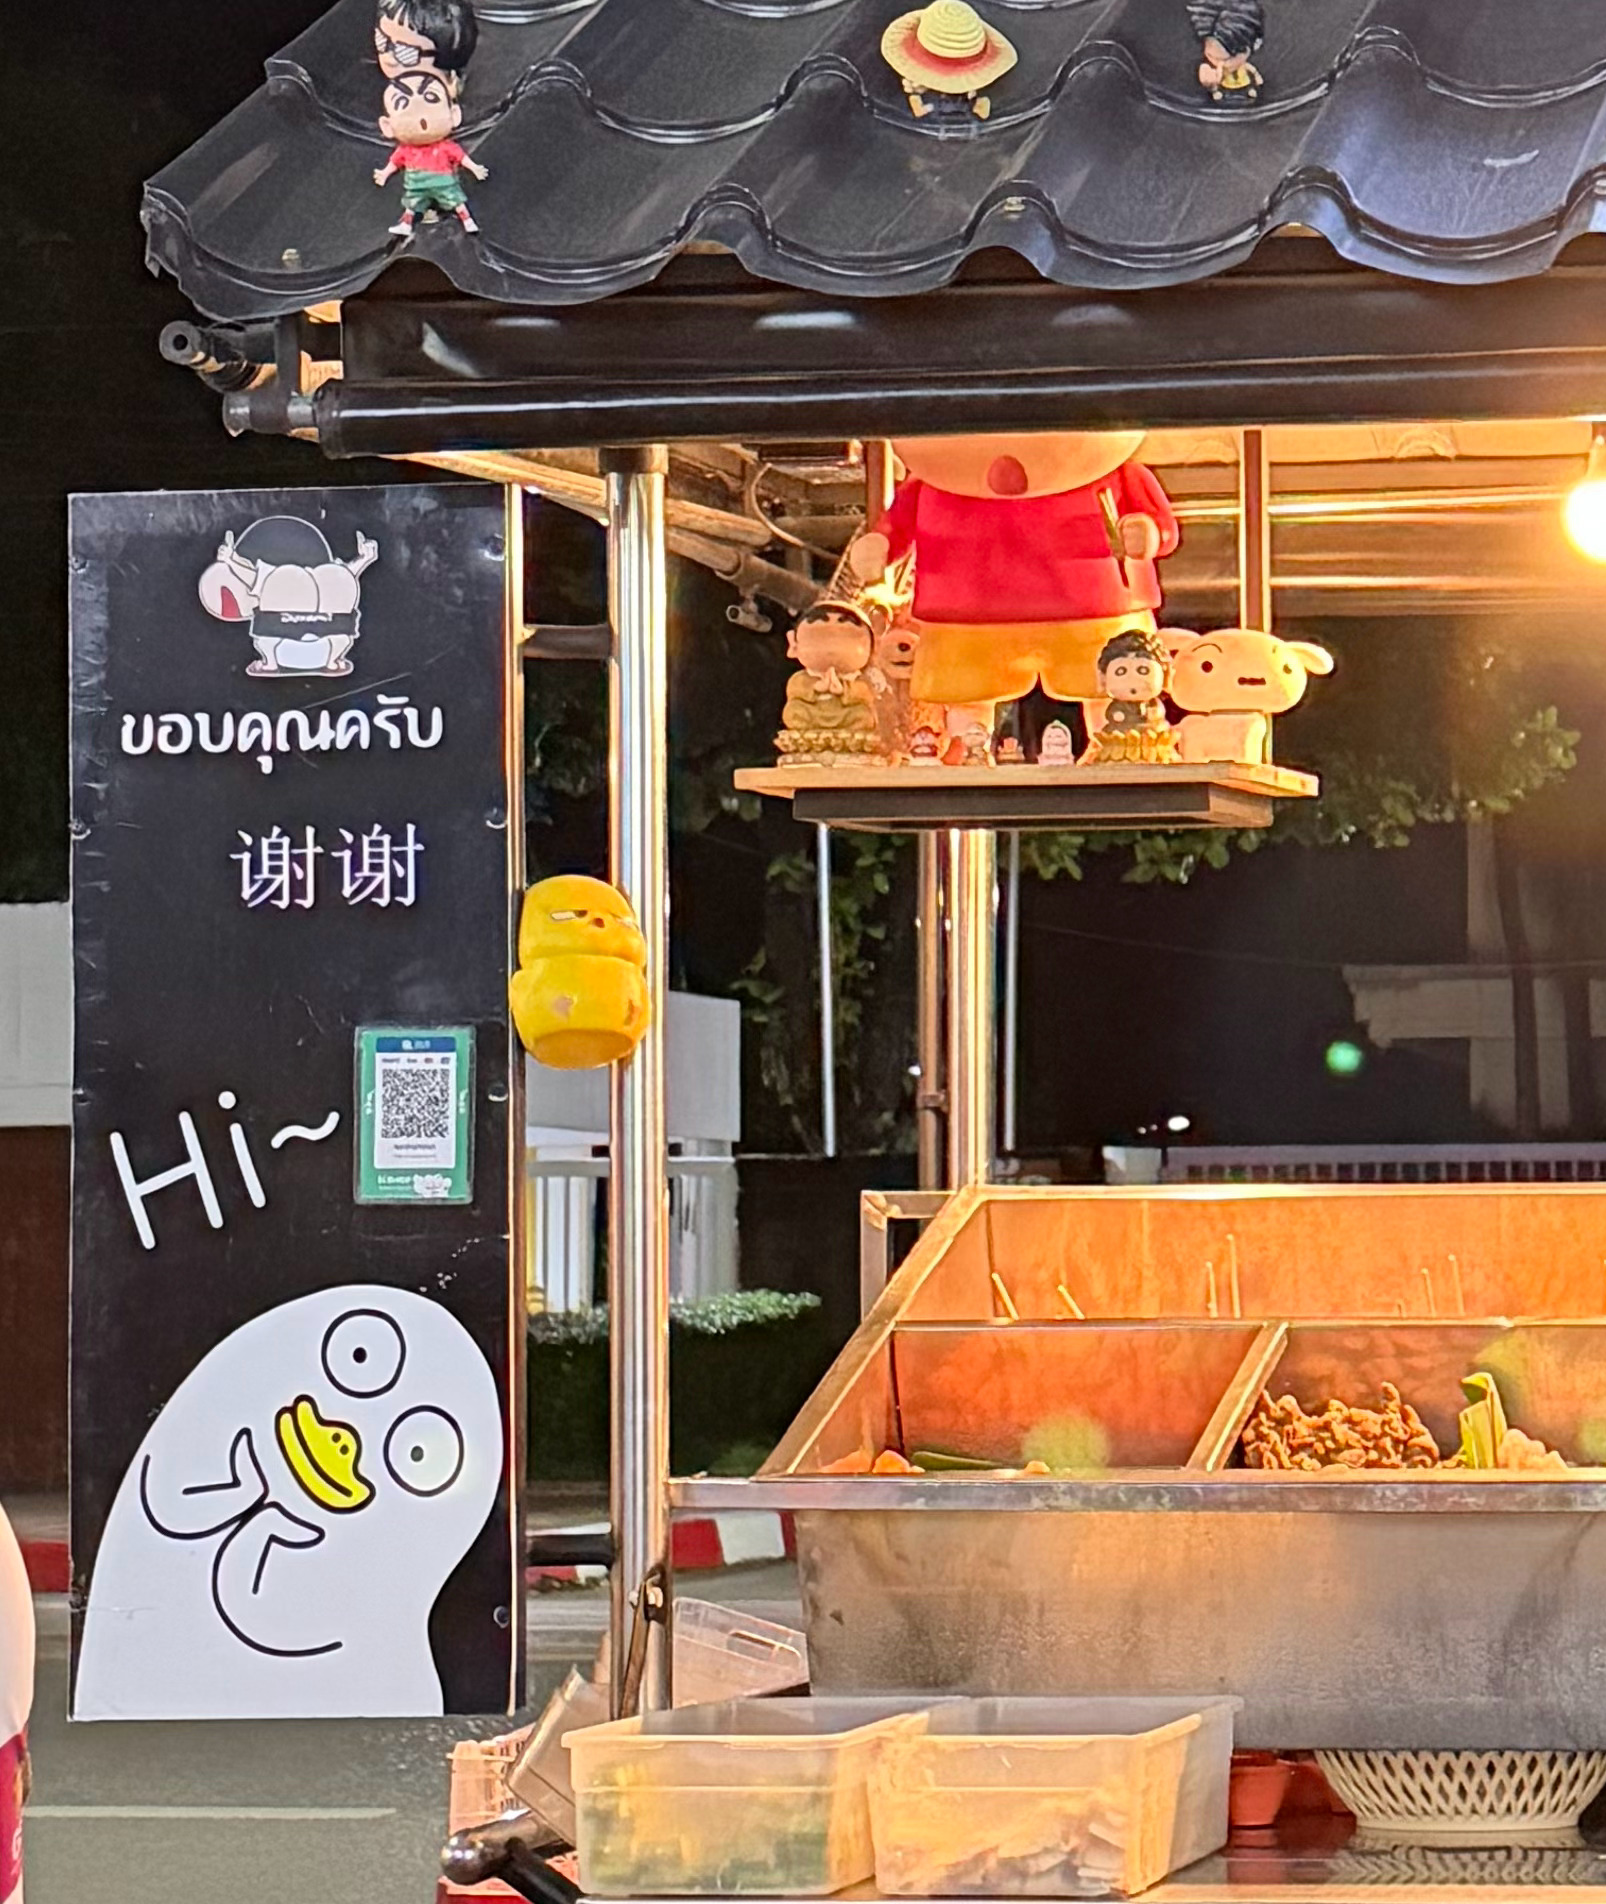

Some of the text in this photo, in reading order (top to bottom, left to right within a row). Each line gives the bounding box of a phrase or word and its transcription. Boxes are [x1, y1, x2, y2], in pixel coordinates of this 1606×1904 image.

[121, 694, 444, 774] ขอบคุณครับ
[229, 822, 426, 909] 谢谢
